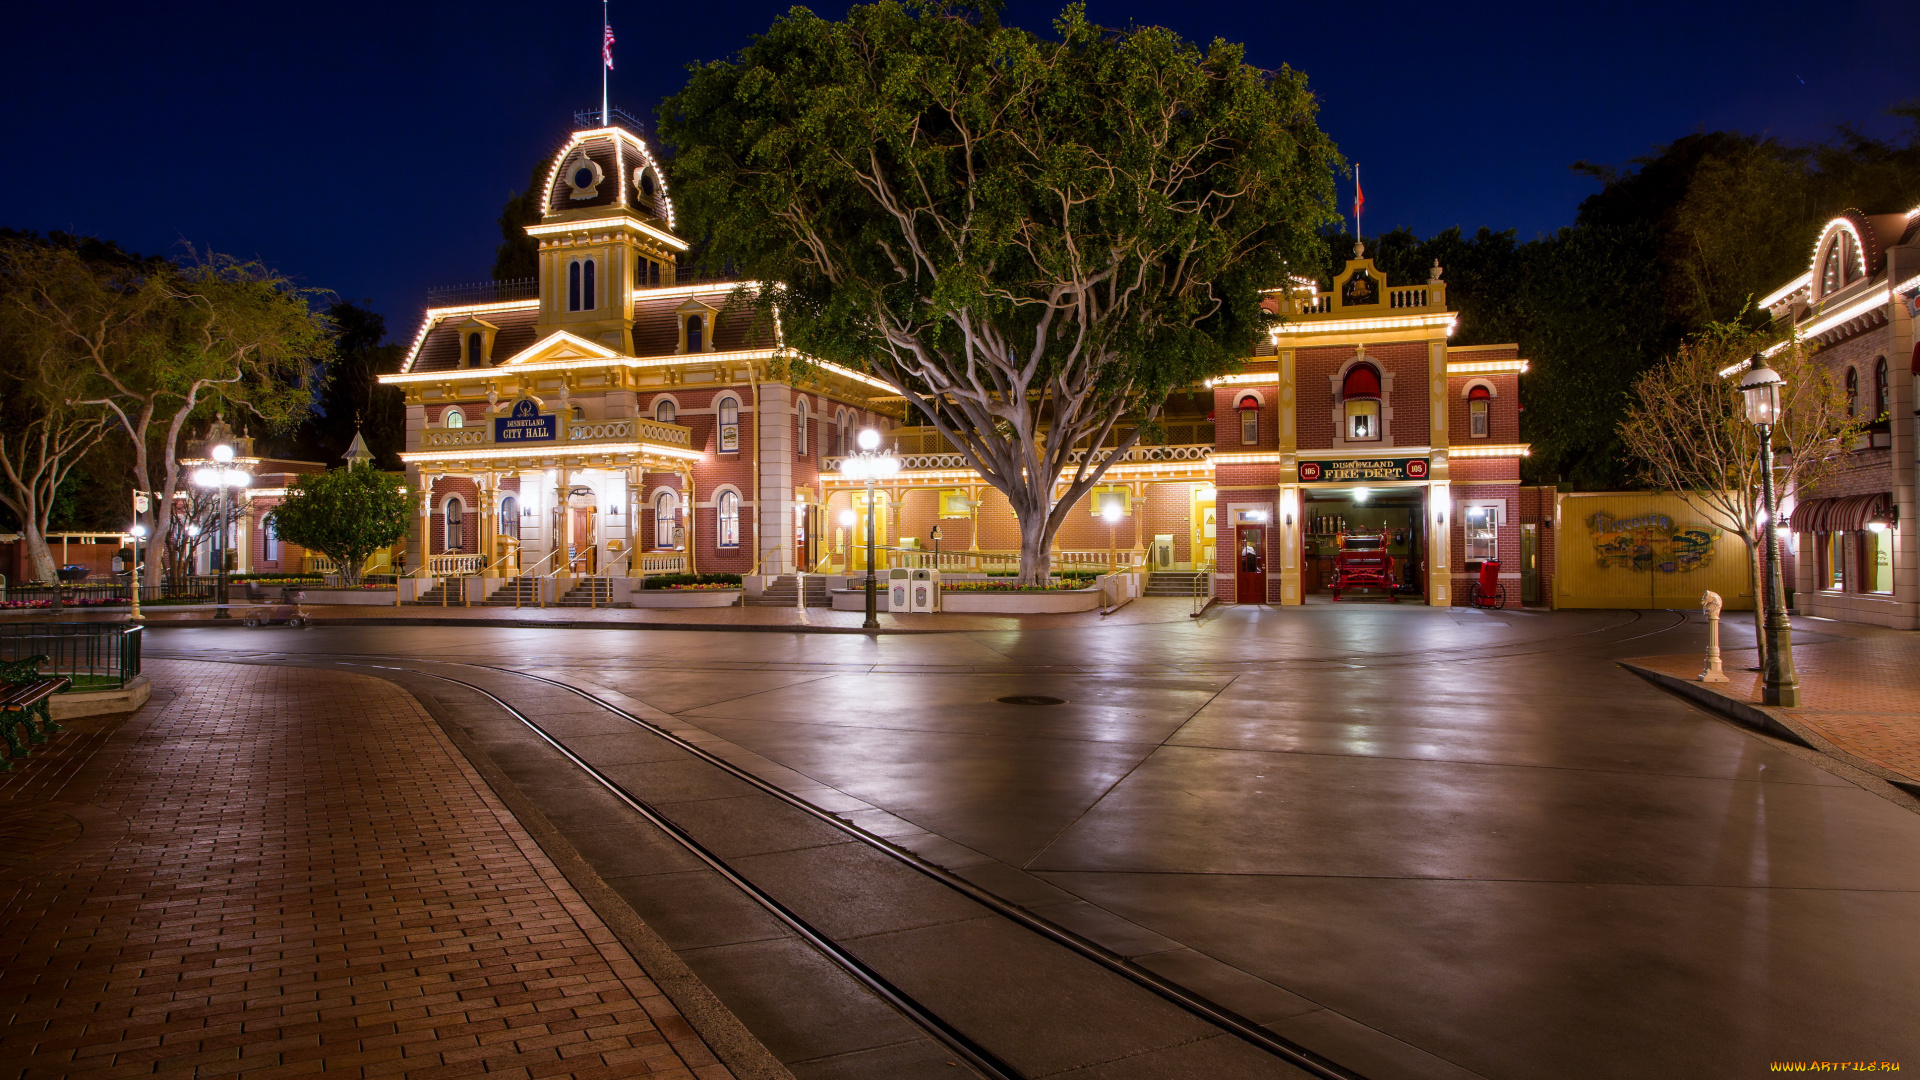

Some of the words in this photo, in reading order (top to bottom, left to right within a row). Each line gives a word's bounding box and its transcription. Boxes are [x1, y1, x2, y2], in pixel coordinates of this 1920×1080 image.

[507, 419, 545, 428] DISNEYLAND
[503, 429, 522, 439] CITY
[526, 427, 549, 438] HALL
[1332, 460, 1394, 469] DISNEYLAND
[1411, 464, 1423, 473] 105
[1304, 467, 1316, 475] 105
[1323, 469, 1360, 479] FIRE
[1363, 467, 1404, 478] DEPT.
